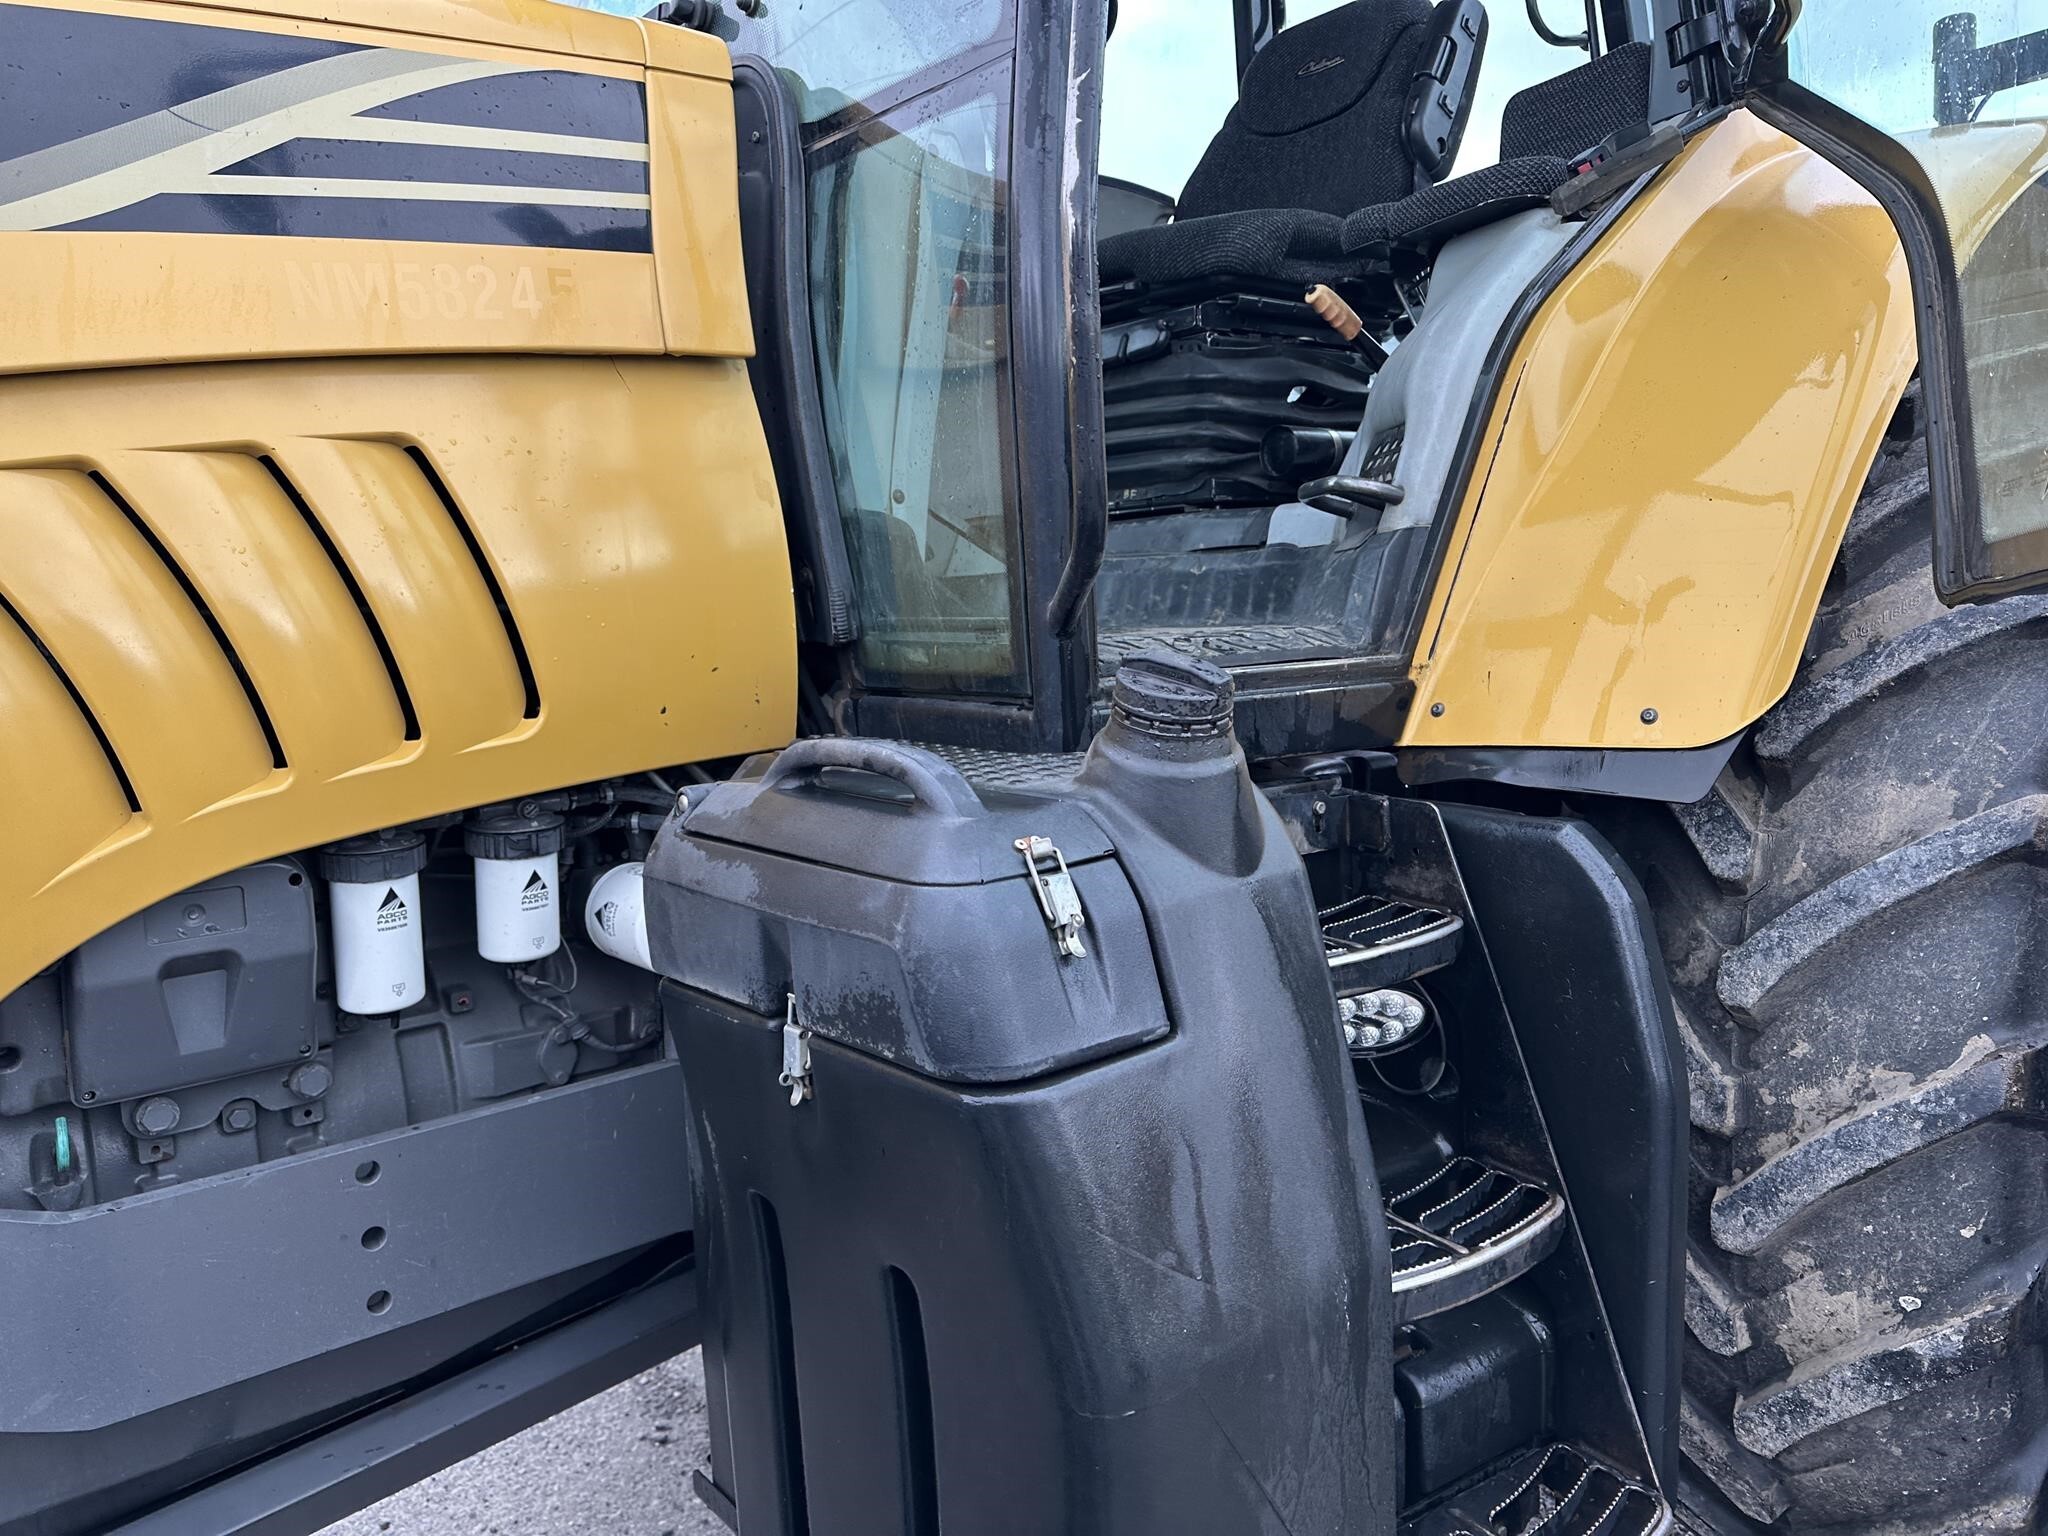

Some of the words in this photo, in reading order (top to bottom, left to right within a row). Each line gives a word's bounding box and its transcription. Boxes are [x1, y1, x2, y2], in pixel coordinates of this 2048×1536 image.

[521, 890, 549, 901] AGCO
[521, 896, 549, 905] PARTS
[376, 909, 408, 920] AGCO
[376, 915, 408, 925] PARTS
